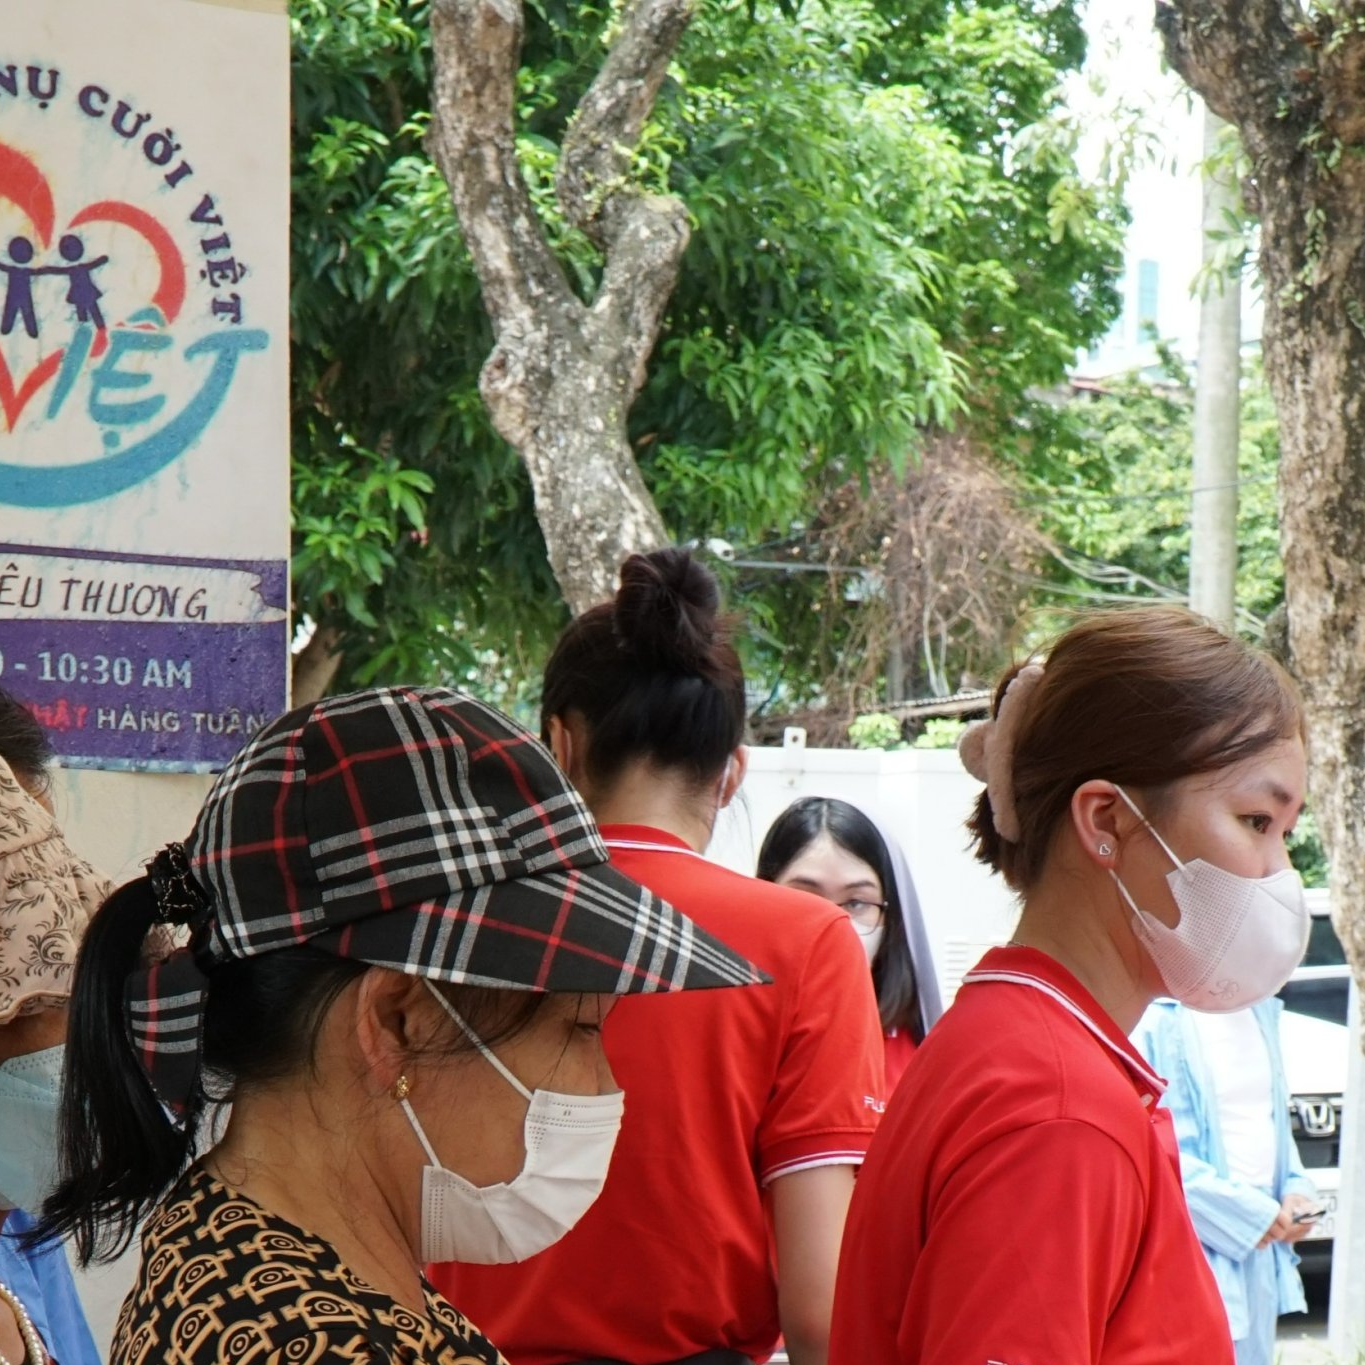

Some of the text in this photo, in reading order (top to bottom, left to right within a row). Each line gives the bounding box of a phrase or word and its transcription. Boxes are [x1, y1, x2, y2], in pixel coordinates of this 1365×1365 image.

[78, 85, 193, 189] CƯỜI
[189, 194, 247, 324] VIỆT
[60, 578, 208, 621] THƯƠNG
[37, 651, 133, 686] 10:30
[142, 658, 193, 689] AM
